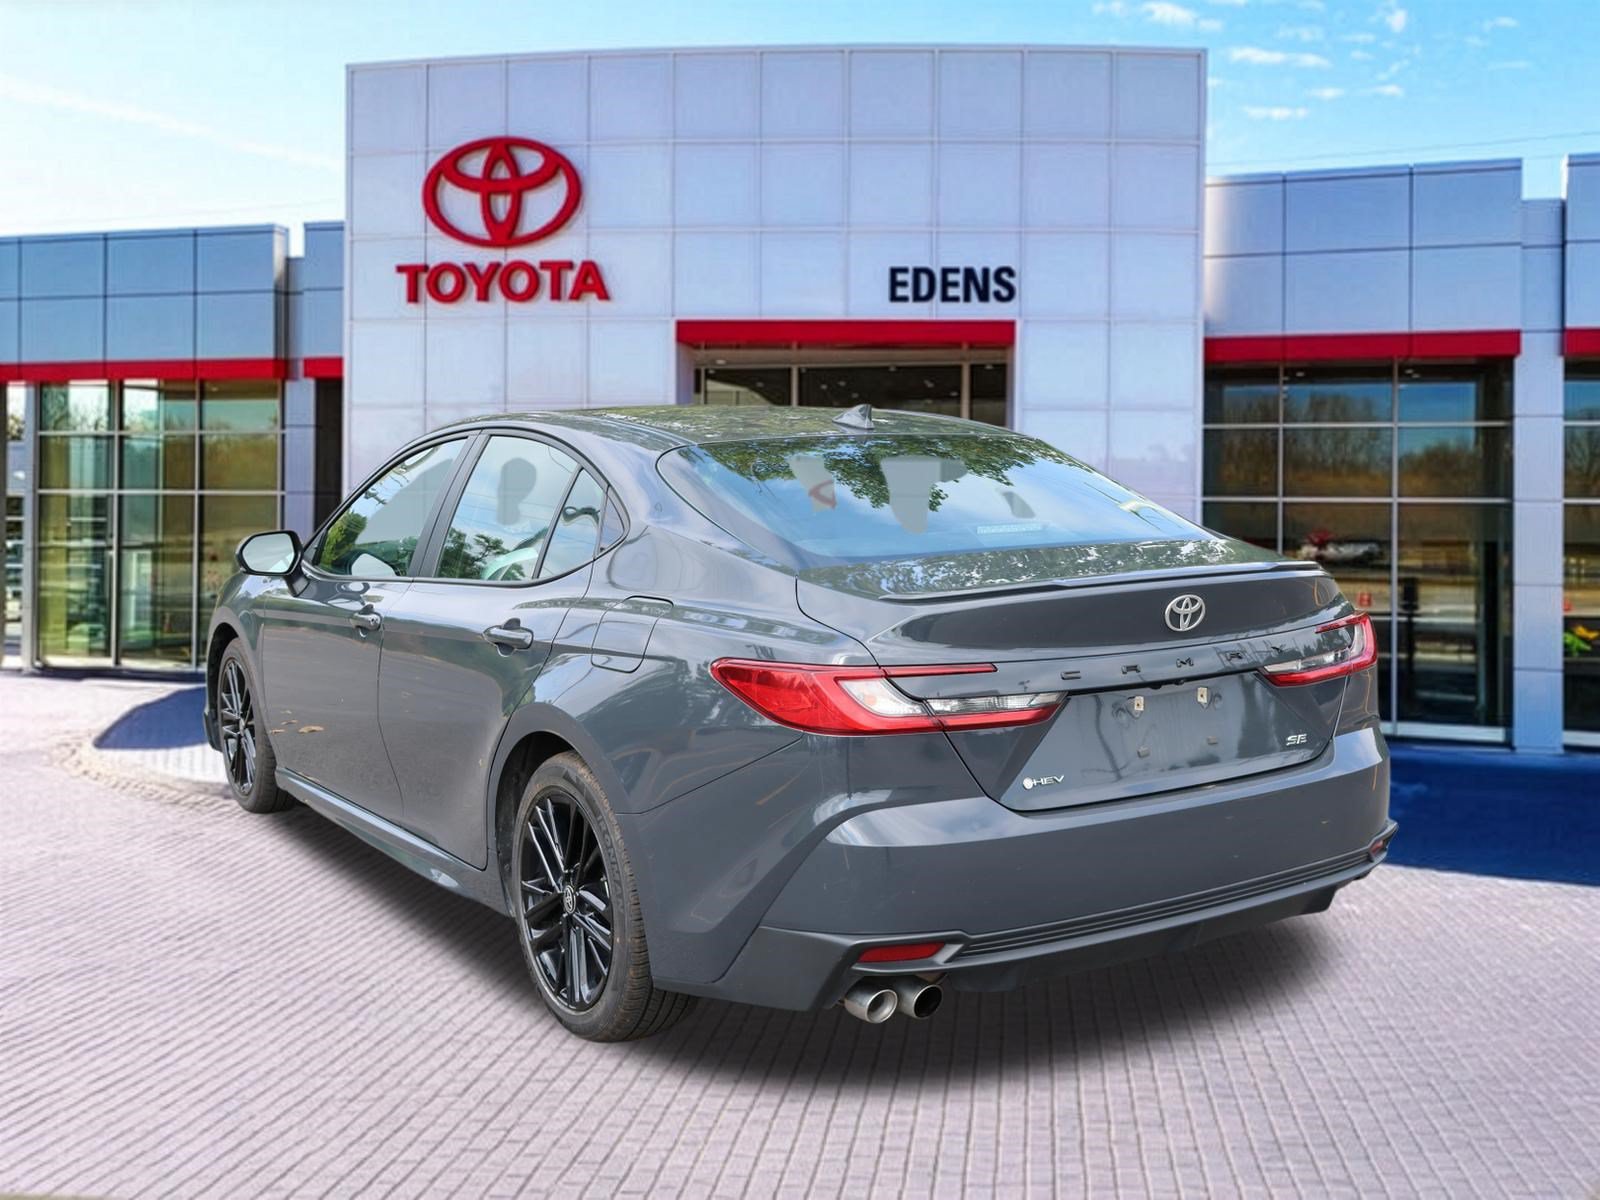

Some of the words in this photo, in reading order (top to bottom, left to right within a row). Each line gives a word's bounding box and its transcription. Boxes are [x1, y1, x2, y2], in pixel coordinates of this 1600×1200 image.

[396, 260, 611, 304] TOYOTA
[889, 266, 1016, 303] EDENS
[1060, 644, 1286, 681] CAMRY
[1286, 733, 1307, 746] SE
[1032, 775, 1065, 786] HEV
